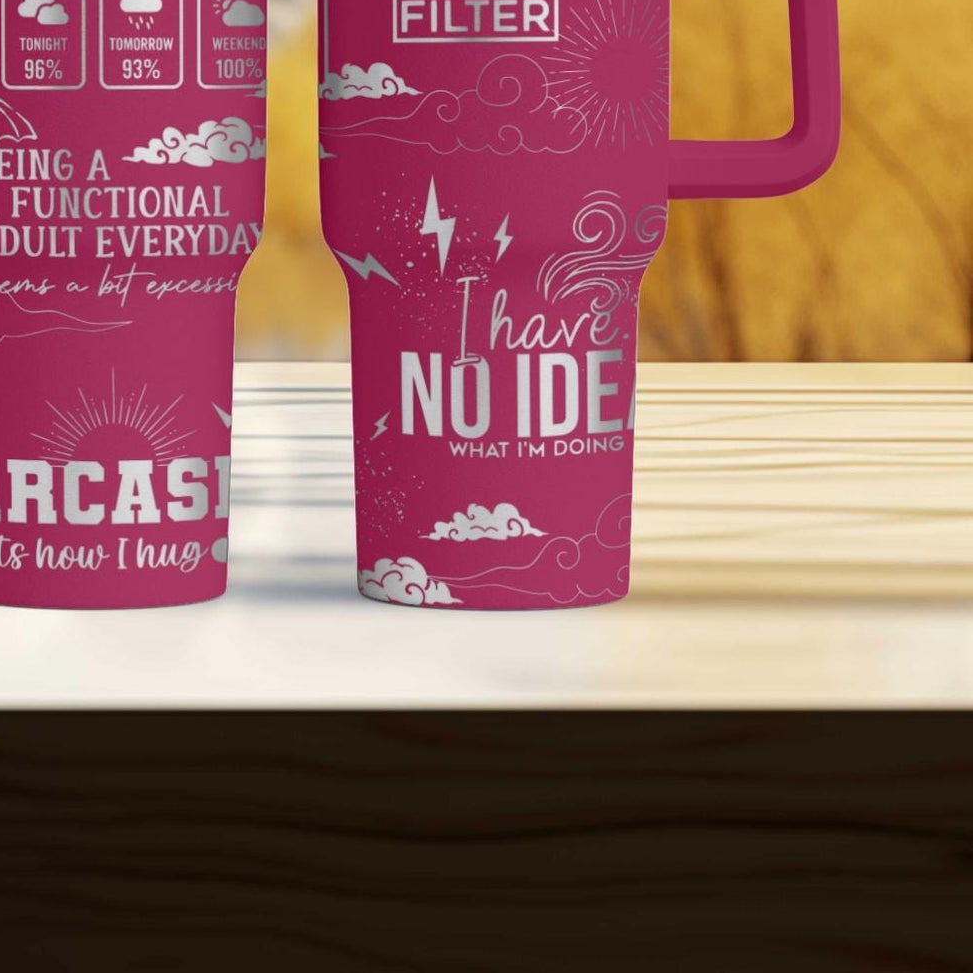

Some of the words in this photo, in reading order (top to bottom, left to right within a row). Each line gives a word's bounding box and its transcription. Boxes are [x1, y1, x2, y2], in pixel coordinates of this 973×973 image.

[401, 0, 550, 33] FILTER
[19, 37, 67, 51] TONIGHT
[109, 37, 174, 51] TOMORROW
[212, 37, 266, 50] WEEKEND
[25, 59, 62, 79] 96%
[122, 59, 160, 79] 93%
[216, 58, 262, 78] 100%
[87, 149, 111, 181] A
[11, 186, 229, 219] FUNCTIONAL
[96, 223, 263, 258] EVERYDAY
[66, 280, 88, 293] a
[98, 263, 156, 307] bit
[489, 289, 619, 351] have
[401, 351, 490, 439] NO
[516, 349, 636, 438] IDE
[449, 441, 509, 458] WHAT
[517, 441, 545, 458] I'M
[554, 436, 625, 456] DOING
[35, 537, 110, 570] how
[117, 537, 129, 570] I
[137, 538, 209, 573] hug
